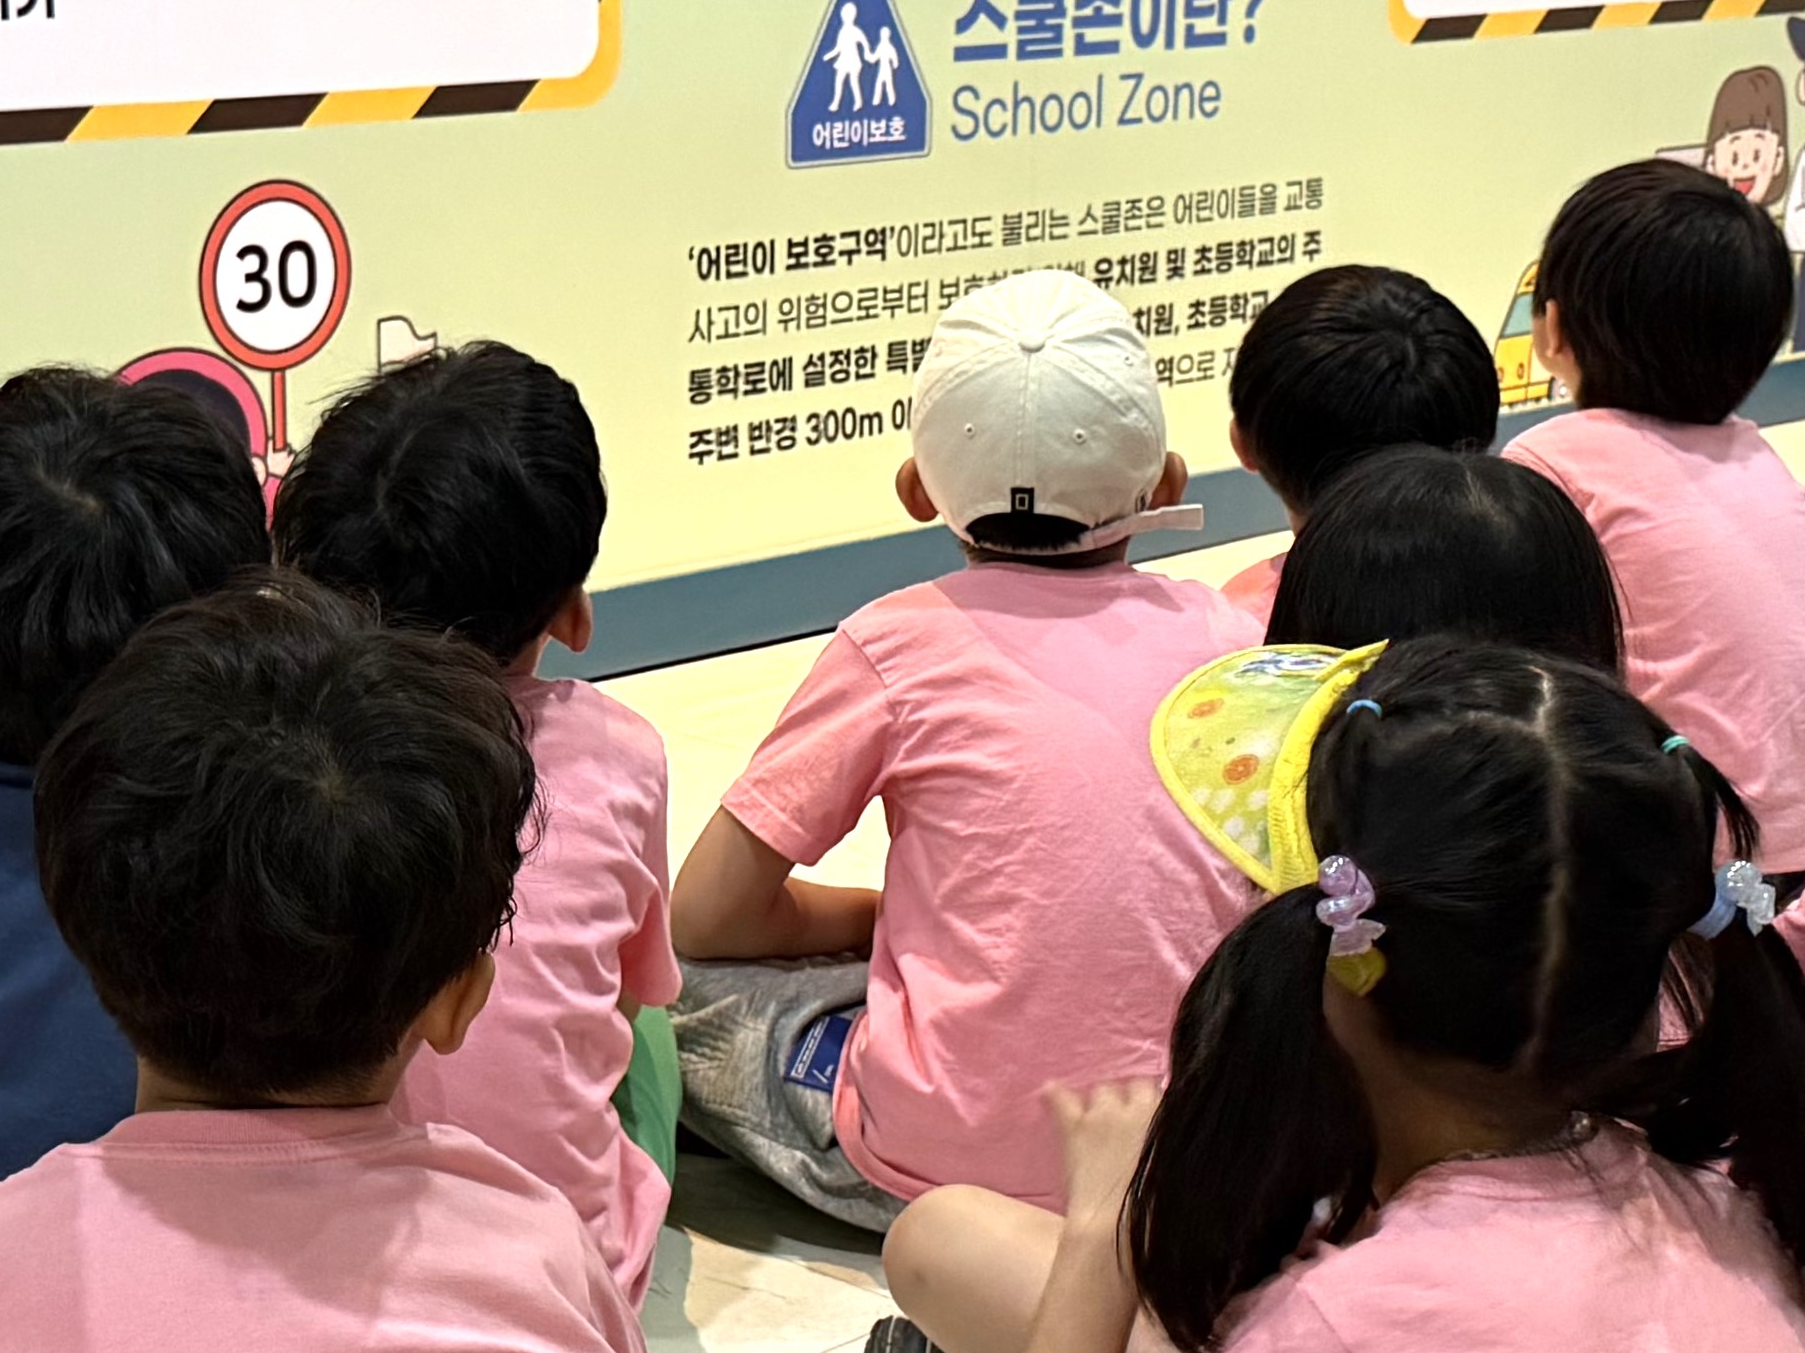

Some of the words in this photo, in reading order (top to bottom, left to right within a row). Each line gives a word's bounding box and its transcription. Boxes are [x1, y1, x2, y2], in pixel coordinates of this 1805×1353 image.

[811, 115, 908, 150] 어린이보호
[950, 72, 1104, 142] School
[1116, 72, 1223, 127] Zone
[1001, 207, 1071, 247] 불리는
[1076, 194, 1167, 238] 스쿨존은
[1172, 182, 1279, 226] 어린이들을
[1283, 175, 1325, 214] 교통
[235, 239, 318, 314] 30
[688, 298, 769, 345] 사고의
[777, 278, 930, 334] 위험으로부터
[1094, 251, 1160, 291] 유치원
[1166, 247, 1187, 281] 및
[1192, 232, 1297, 278] 초등학교의
[1301, 229, 1323, 264] 주
[1132, 302, 1180, 339] 치원,
[687, 355, 794, 406] 통학로에
[802, 344, 879, 389] 설정한
[1155, 349, 1217, 389] 역으로
[687, 423, 740, 466] 주변
[747, 413, 798, 457] 반경
[805, 406, 884, 447] 300m
